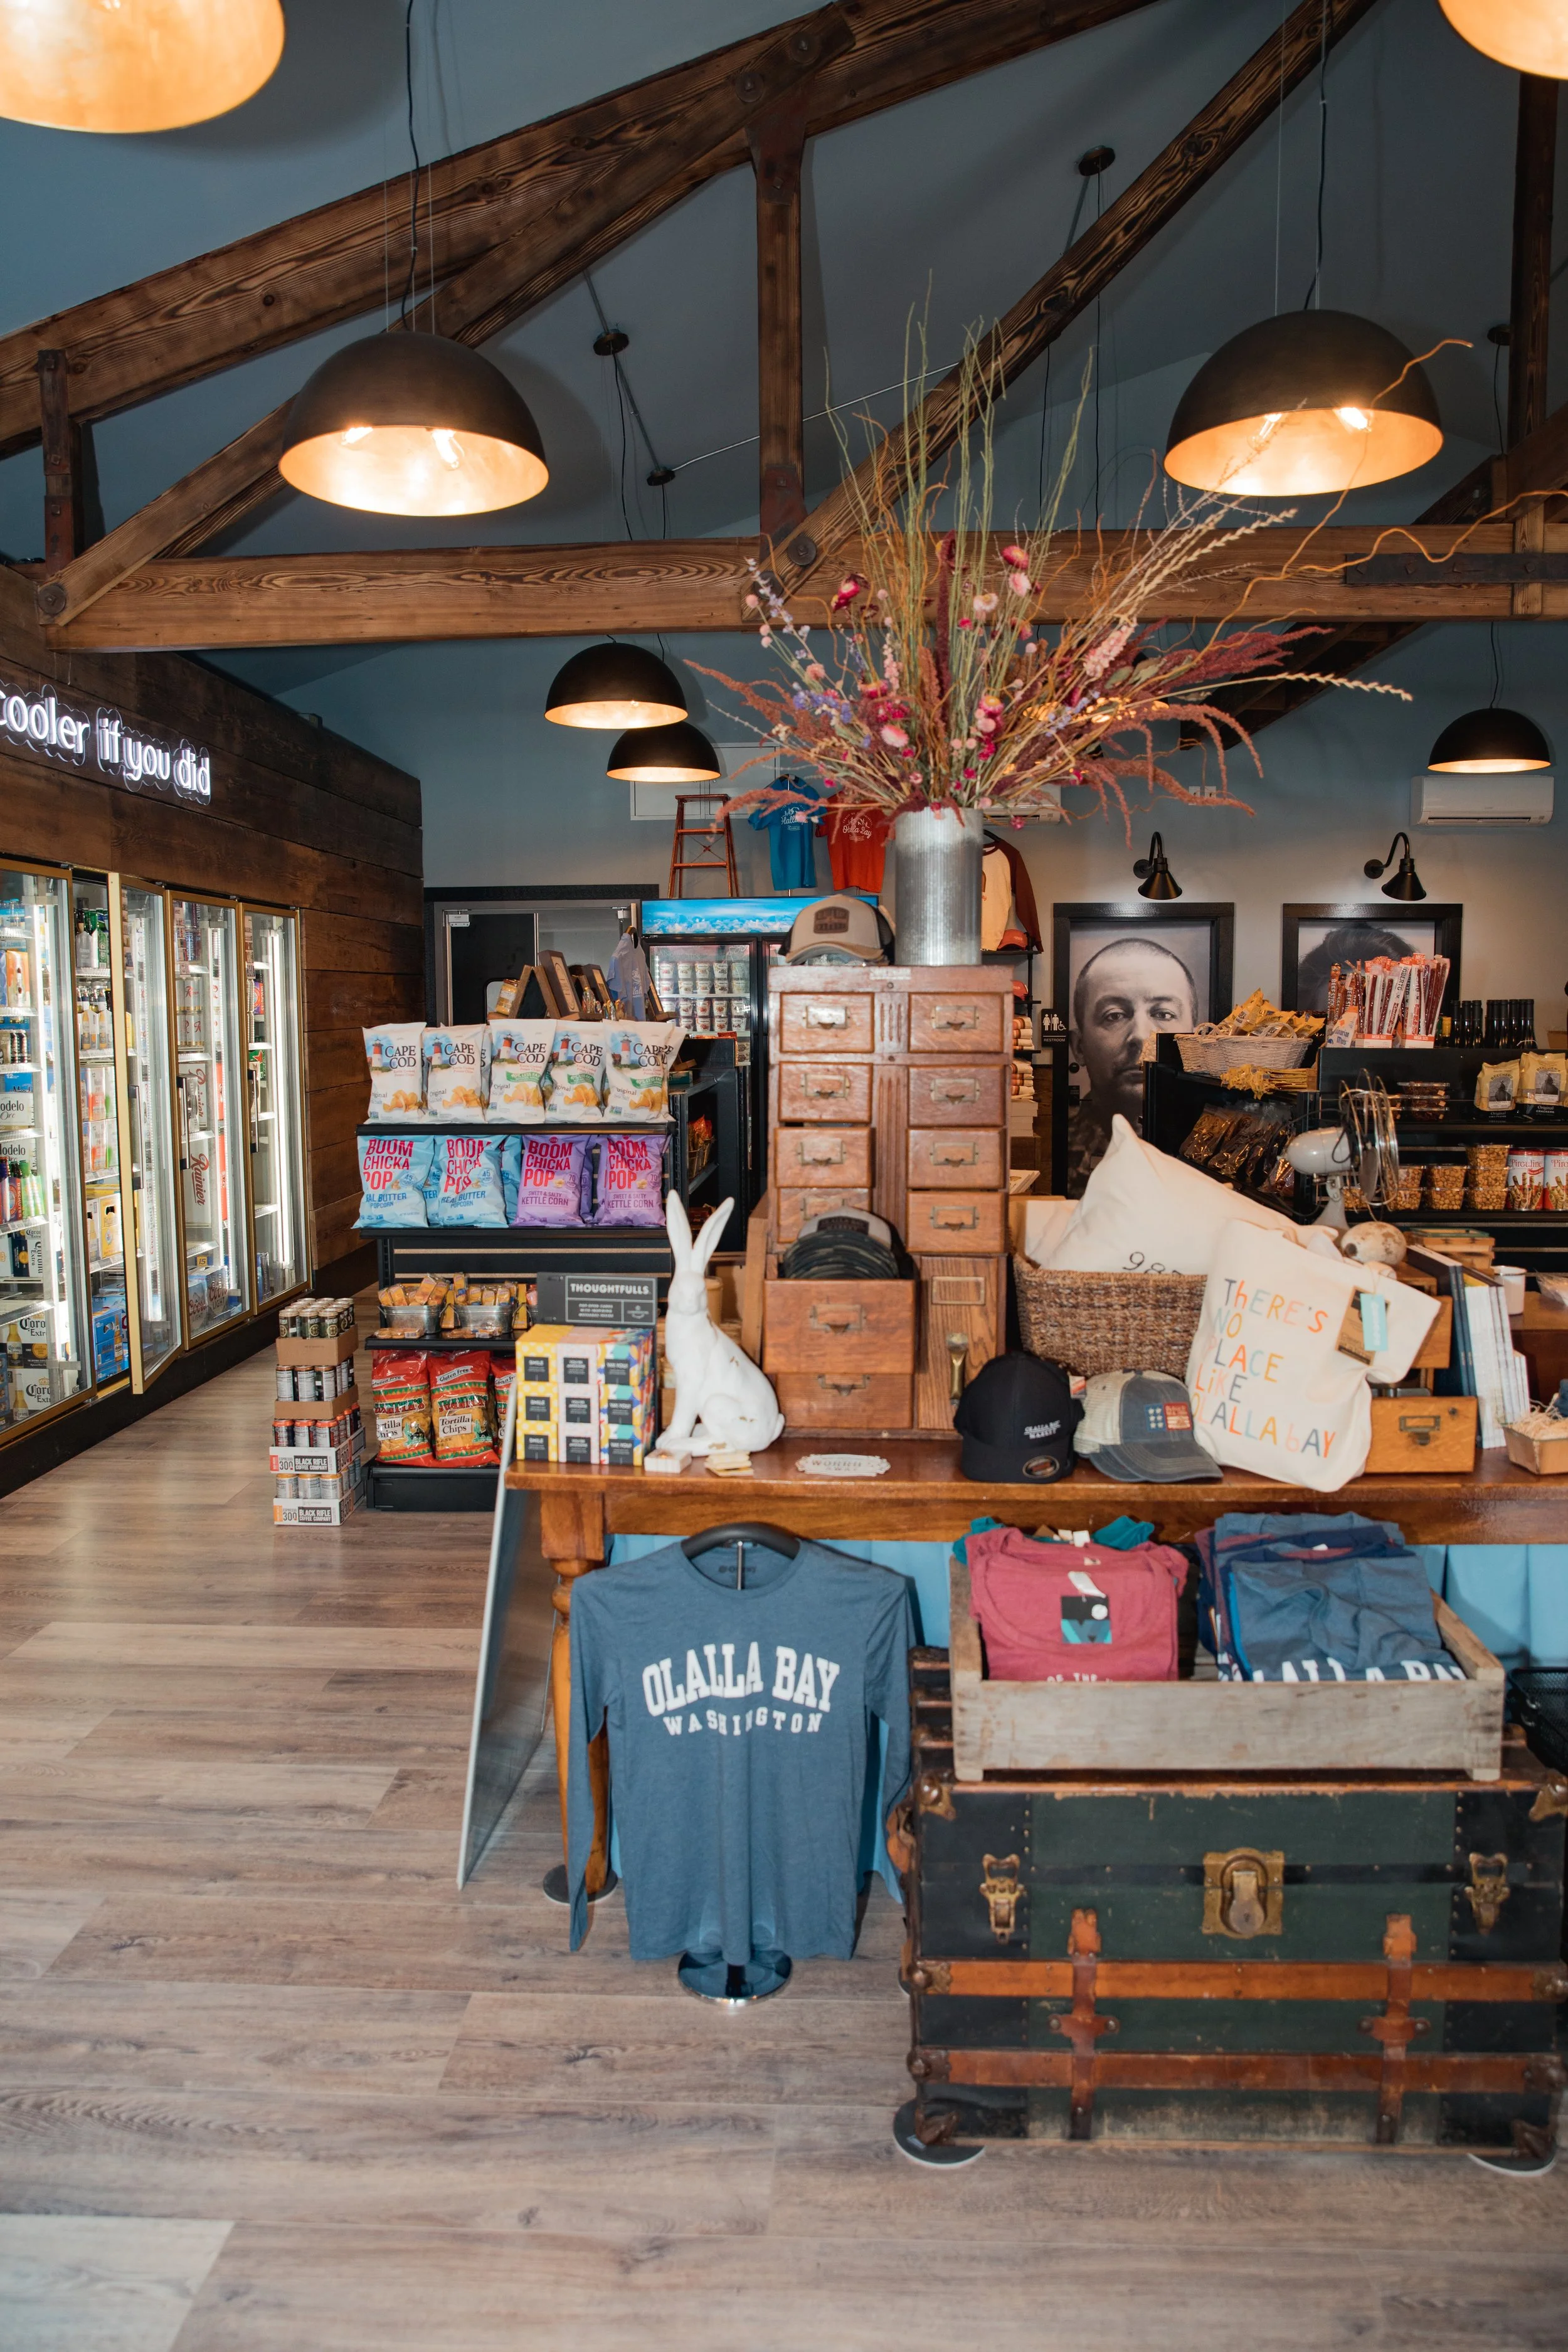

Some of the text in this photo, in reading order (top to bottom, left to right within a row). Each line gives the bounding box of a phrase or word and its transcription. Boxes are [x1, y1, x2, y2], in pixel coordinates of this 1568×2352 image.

[100, 718, 124, 763] if
[123, 736, 170, 781] you
[173, 749, 210, 795] did
[384, 1046, 416, 1057] CAPE
[444, 1042, 475, 1056] CAPE
[514, 1042, 547, 1053] CAPE
[571, 1042, 603, 1056] CAPE
[389, 1057, 416, 1069] COD
[448, 1054, 475, 1066] COD
[517, 1053, 545, 1063] COD
[573, 1053, 601, 1066] COD
[0, 1100, 24, 1112] odelo
[366, 1138, 414, 1157] BOOM
[527, 1140, 573, 1158] BOOM
[607, 1138, 648, 1158] BOOM
[363, 1155, 410, 1170] CHICKA
[526, 1154, 571, 1170] CHICKA
[608, 1155, 652, 1172] CHICKA
[1509, 1158, 1541, 1167] Pirouline
[190, 1153, 209, 1206] Rainier
[523, 1168, 555, 1187] POP
[608, 1170, 637, 1190] POP
[378, 1192, 407, 1202] BUTTER
[458, 1190, 485, 1201] BUTTER
[521, 1196, 569, 1207] KETTLE CORN
[450, 1200, 474, 1208] POPCORN
[608, 1199, 654, 1208] KETTLE CORN
[569, 1283, 649, 1295] THOUGHTFULLS
[1213, 1307, 1242, 1338] NO
[439, 1372, 457, 1382] Gluten
[440, 1416, 470, 1426] Tortilla
[442, 1425, 467, 1435] Chips
[279, 1461, 293, 1470] 300
[283, 1512, 297, 1521] 300
[642, 1641, 840, 1717] OLALLA BAY
[663, 1707, 822, 1736] WASHINGTON
